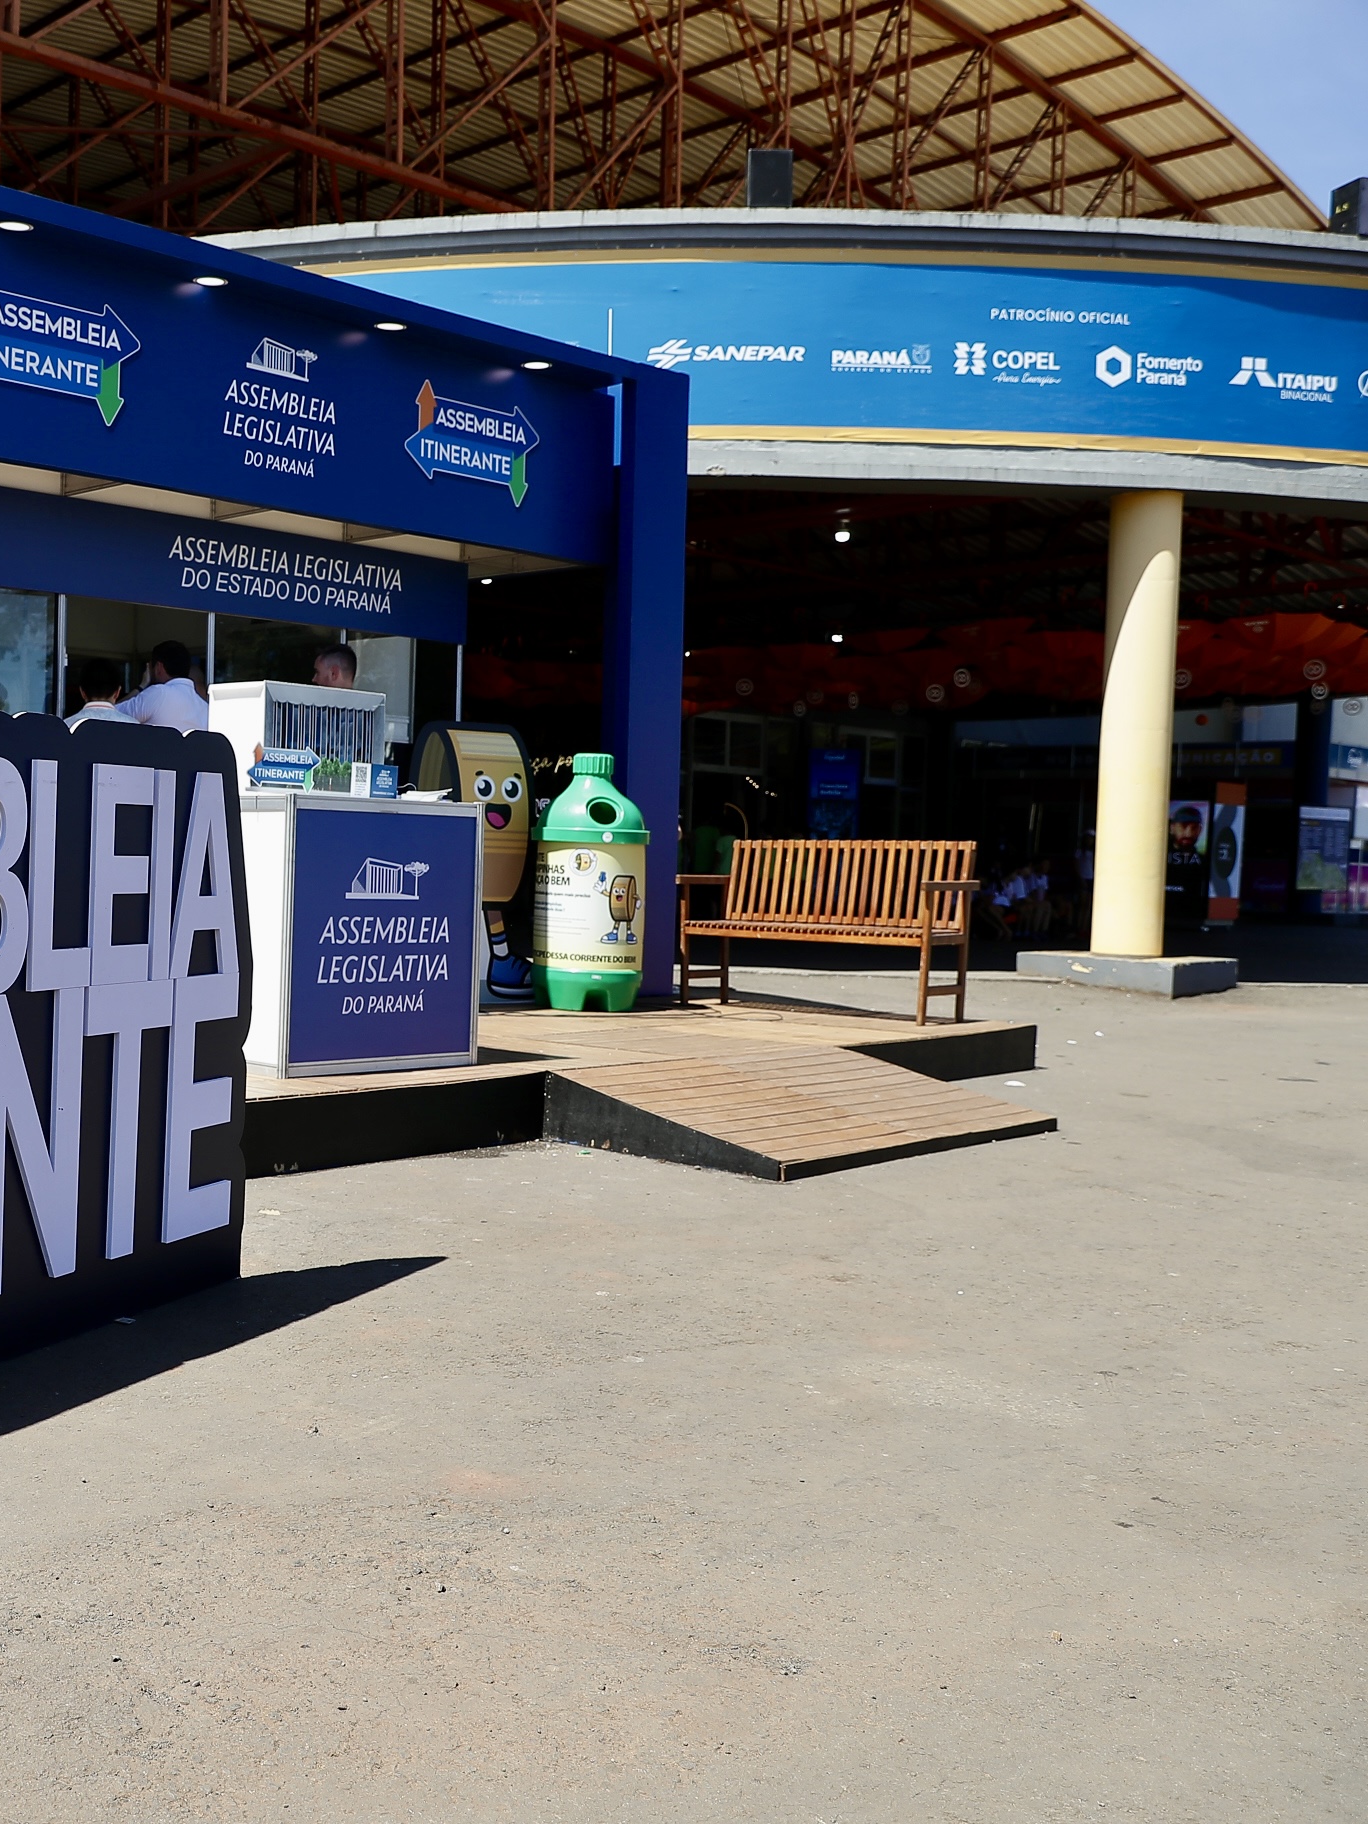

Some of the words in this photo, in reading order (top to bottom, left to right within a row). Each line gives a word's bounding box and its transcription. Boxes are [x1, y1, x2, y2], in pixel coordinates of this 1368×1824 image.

[990, 307, 1076, 323] PATROCÍNIO
[1077, 311, 1131, 325] OFICIAL
[692, 345, 806, 362] SANEPAR
[831, 348, 912, 366] PARANÁ
[991, 350, 1061, 370] COPEL
[1136, 352, 1203, 372] Fomento
[1136, 368, 1187, 387] Paraná
[1277, 372, 1338, 392] ITAIPU
[224, 379, 336, 425] ASSEMBLEIA
[1280, 390, 1334, 403] BINACIONAL
[223, 411, 335, 456] LEGISLATIVA
[435, 407, 527, 445] ASSEMBLEIA
[244, 450, 263, 467] DO
[265, 454, 315, 478] PARANÁ
[420, 438, 511, 475] ITINERANTE
[168, 535, 289, 575] ASSEMBLEIA
[293, 553, 402, 591] LEGISLATIVA
[181, 567, 211, 589] DO
[215, 571, 290, 600] ESTADO
[294, 581, 321, 604] DO
[324, 587, 391, 614] PARANÁ
[263, 752, 314, 766] ASSEMBLEIA
[254, 767, 305, 780] ITINERANTE
[550, 876, 570, 886] BEM
[319, 916, 450, 944] ASSEMBLEIA
[546, 951, 568, 960] DESSA
[569, 953, 612, 963] CORRENTE
[317, 954, 449, 984] LEGISLATIVA
[342, 996, 364, 1015] DO
[367, 989, 424, 1014] PARANÁ
